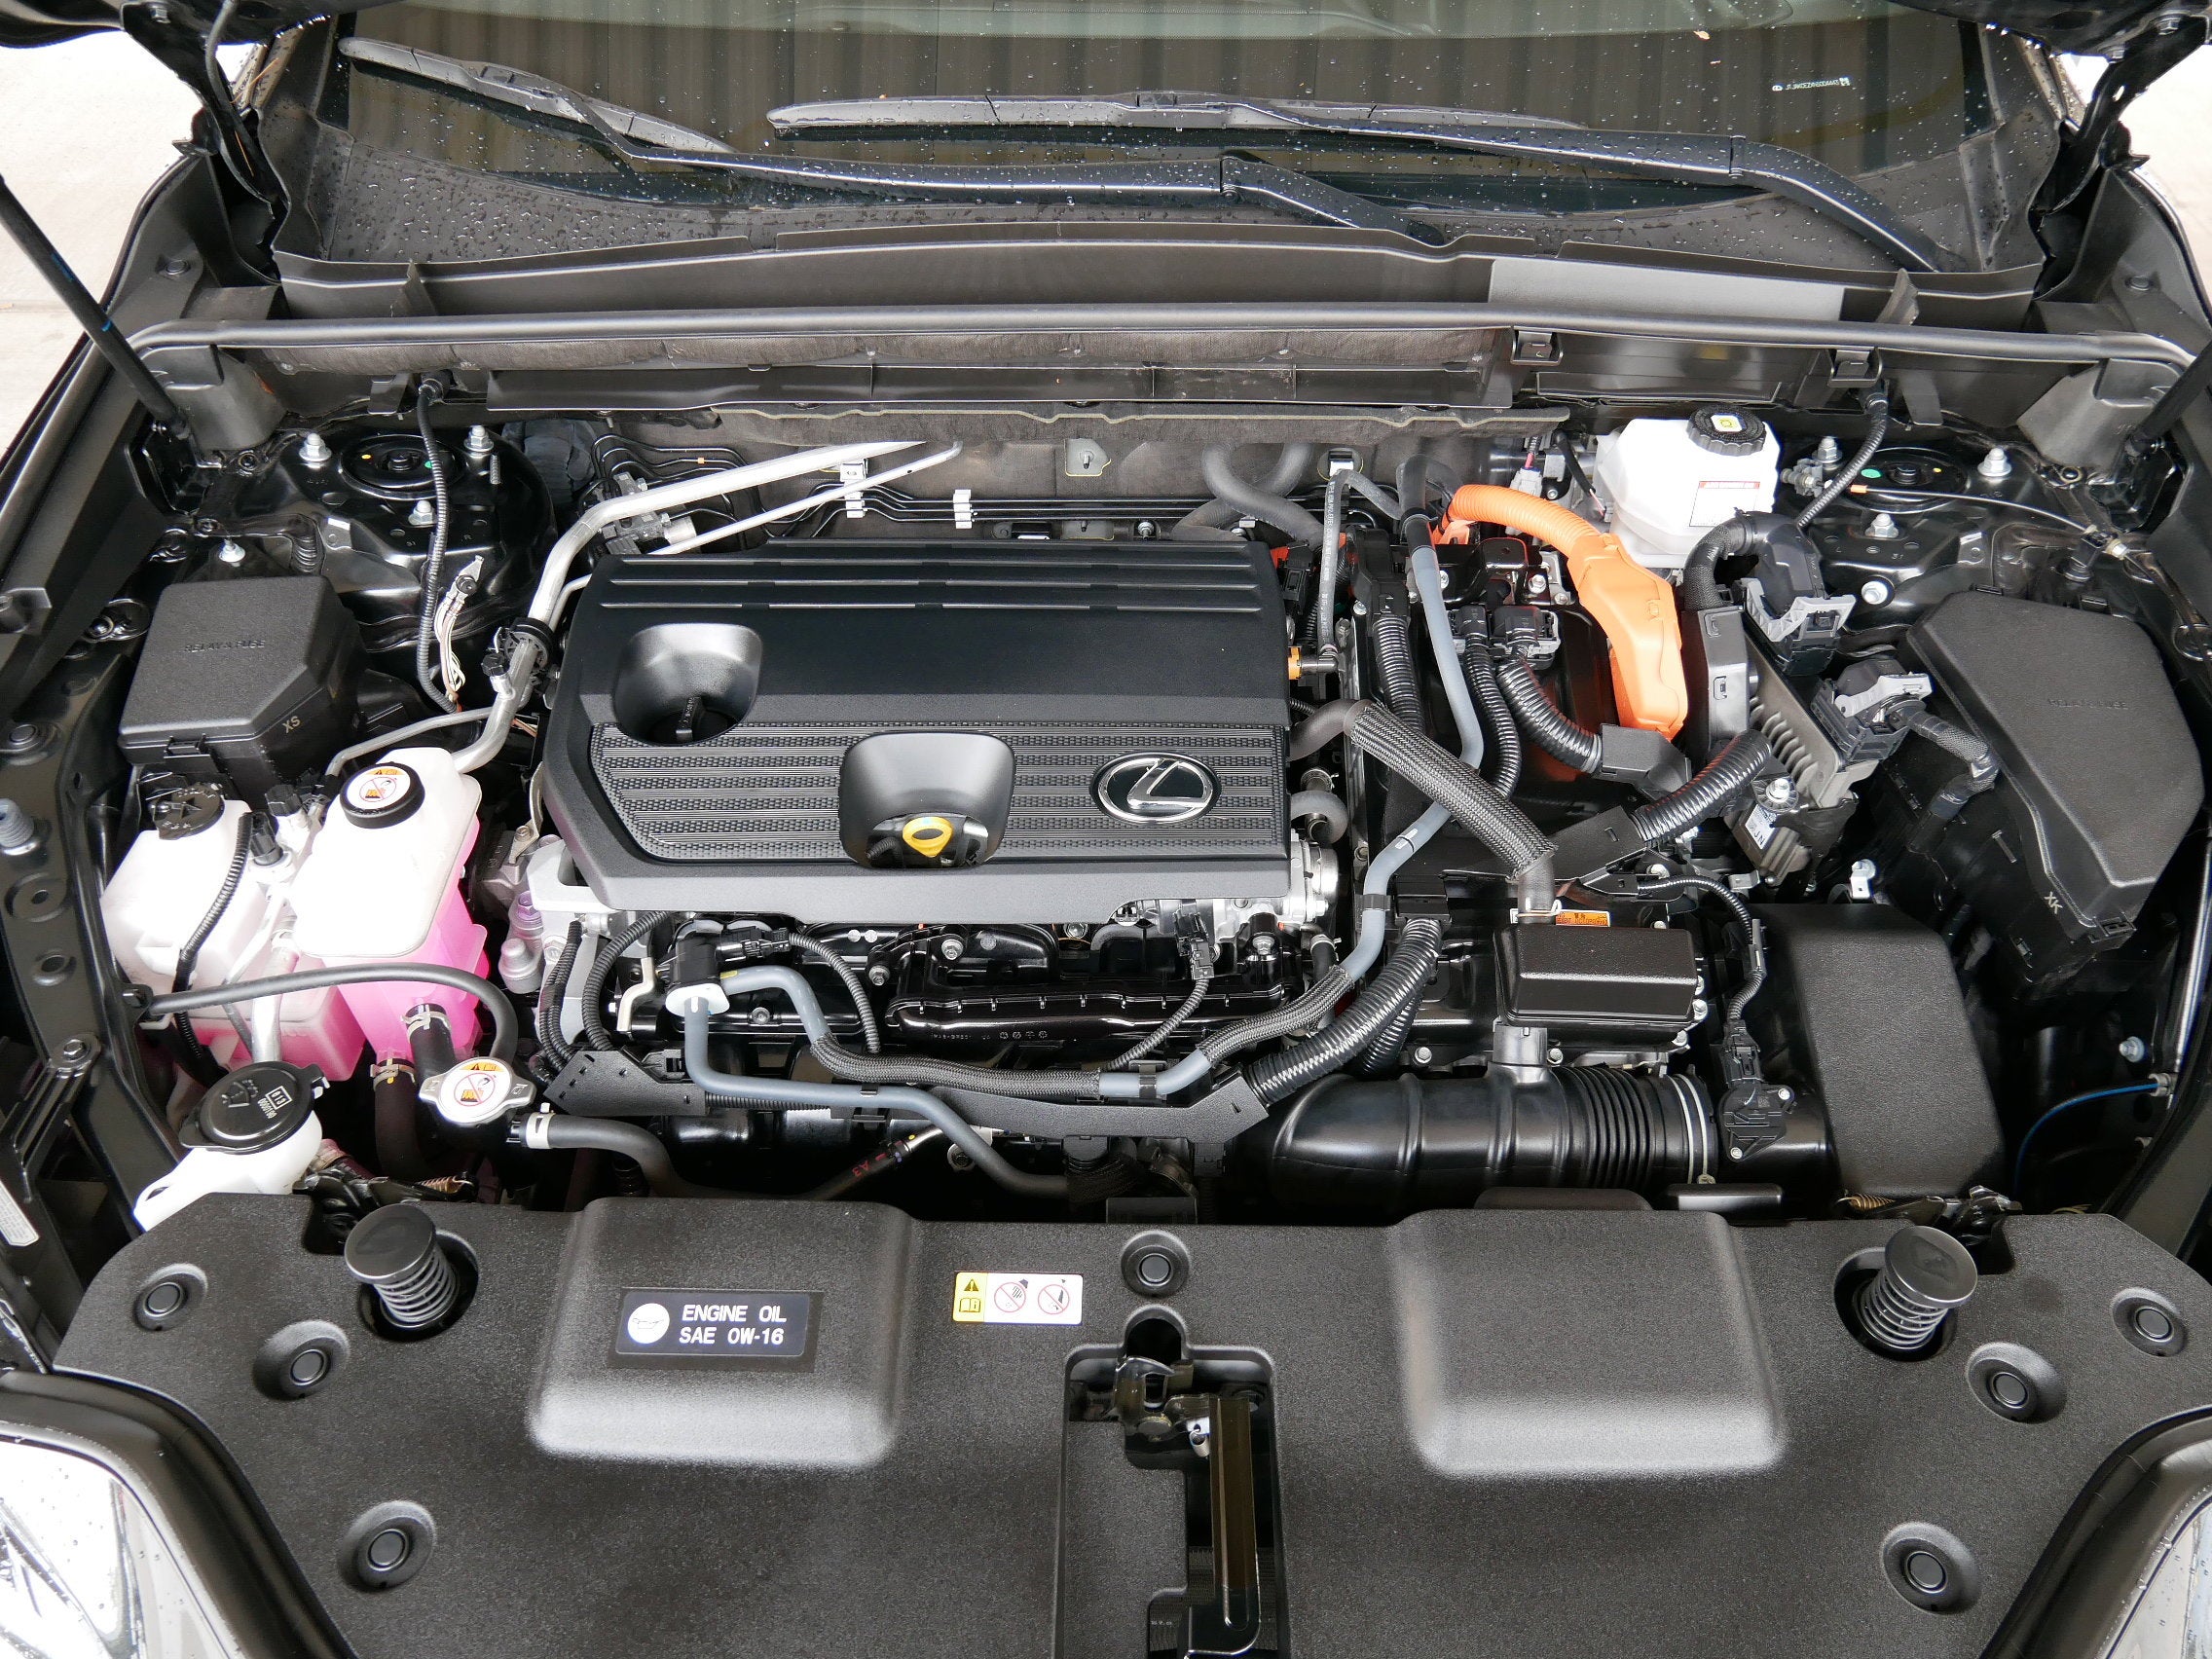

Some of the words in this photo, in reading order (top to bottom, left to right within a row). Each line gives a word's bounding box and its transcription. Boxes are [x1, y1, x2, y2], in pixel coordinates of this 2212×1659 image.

[281, 716, 301, 734] XS
[2044, 891, 2063, 915] XK
[682, 1304, 749, 1322] ENGINE
[758, 1305, 788, 1323] OIL
[679, 1326, 718, 1345] SAE
[727, 1327, 785, 1346] 0W-16
